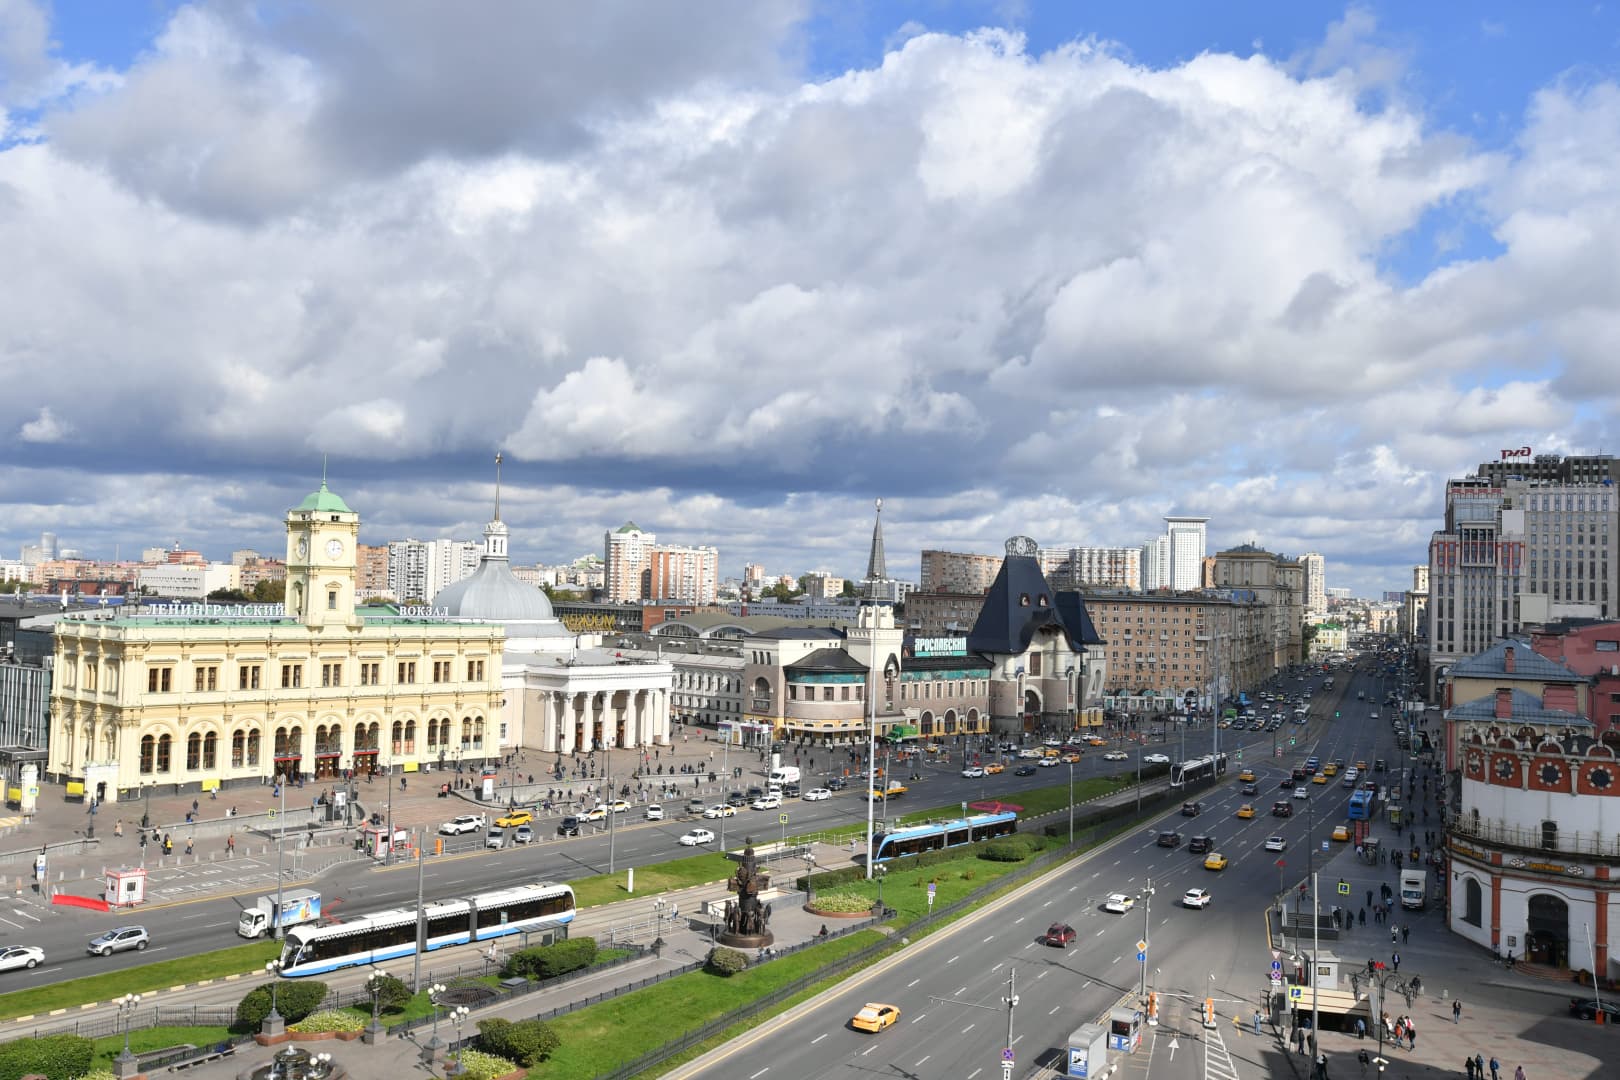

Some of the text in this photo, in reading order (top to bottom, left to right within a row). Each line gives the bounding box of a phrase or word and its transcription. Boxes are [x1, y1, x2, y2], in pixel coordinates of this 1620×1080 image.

[146, 602, 449, 617] ЛЕНИНГРАДСКИЙ ВОКЗАЛ
[915, 637, 967, 651] ЯРОСЛАВСКИЙ
